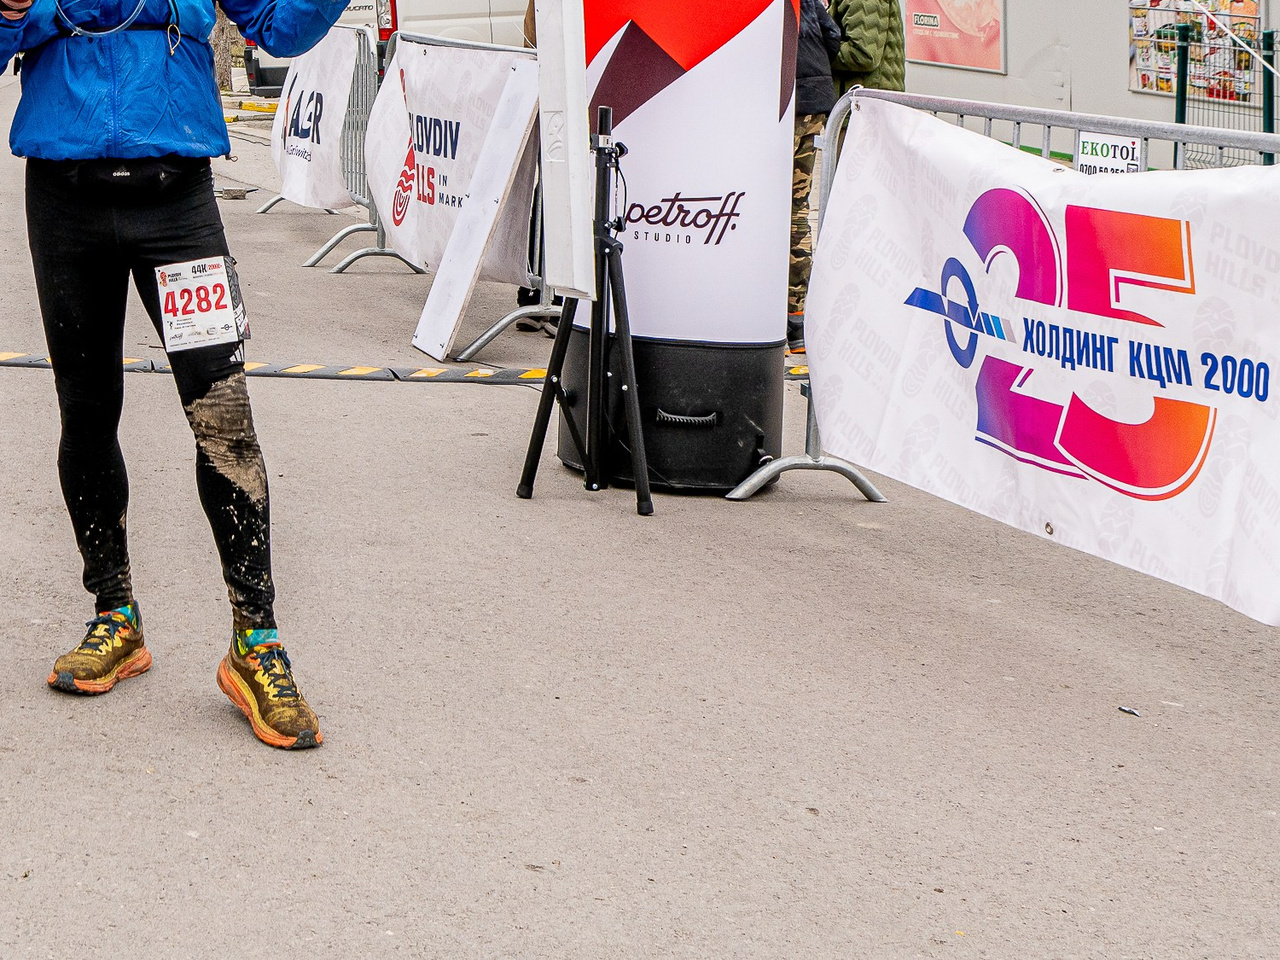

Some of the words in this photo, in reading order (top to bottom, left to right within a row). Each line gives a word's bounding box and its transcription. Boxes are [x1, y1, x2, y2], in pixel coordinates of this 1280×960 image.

[416, 163, 435, 206] LLS
[438, 174, 448, 185] IN
[438, 192, 464, 208] MARK
[634, 230, 691, 244] STUDIO
[163, 283, 228, 318] 4282
[1022, 317, 1119, 373] ХОЛДИНГ
[1129, 340, 1193, 389] КЦМ
[1201, 352, 1270, 402] 2000
